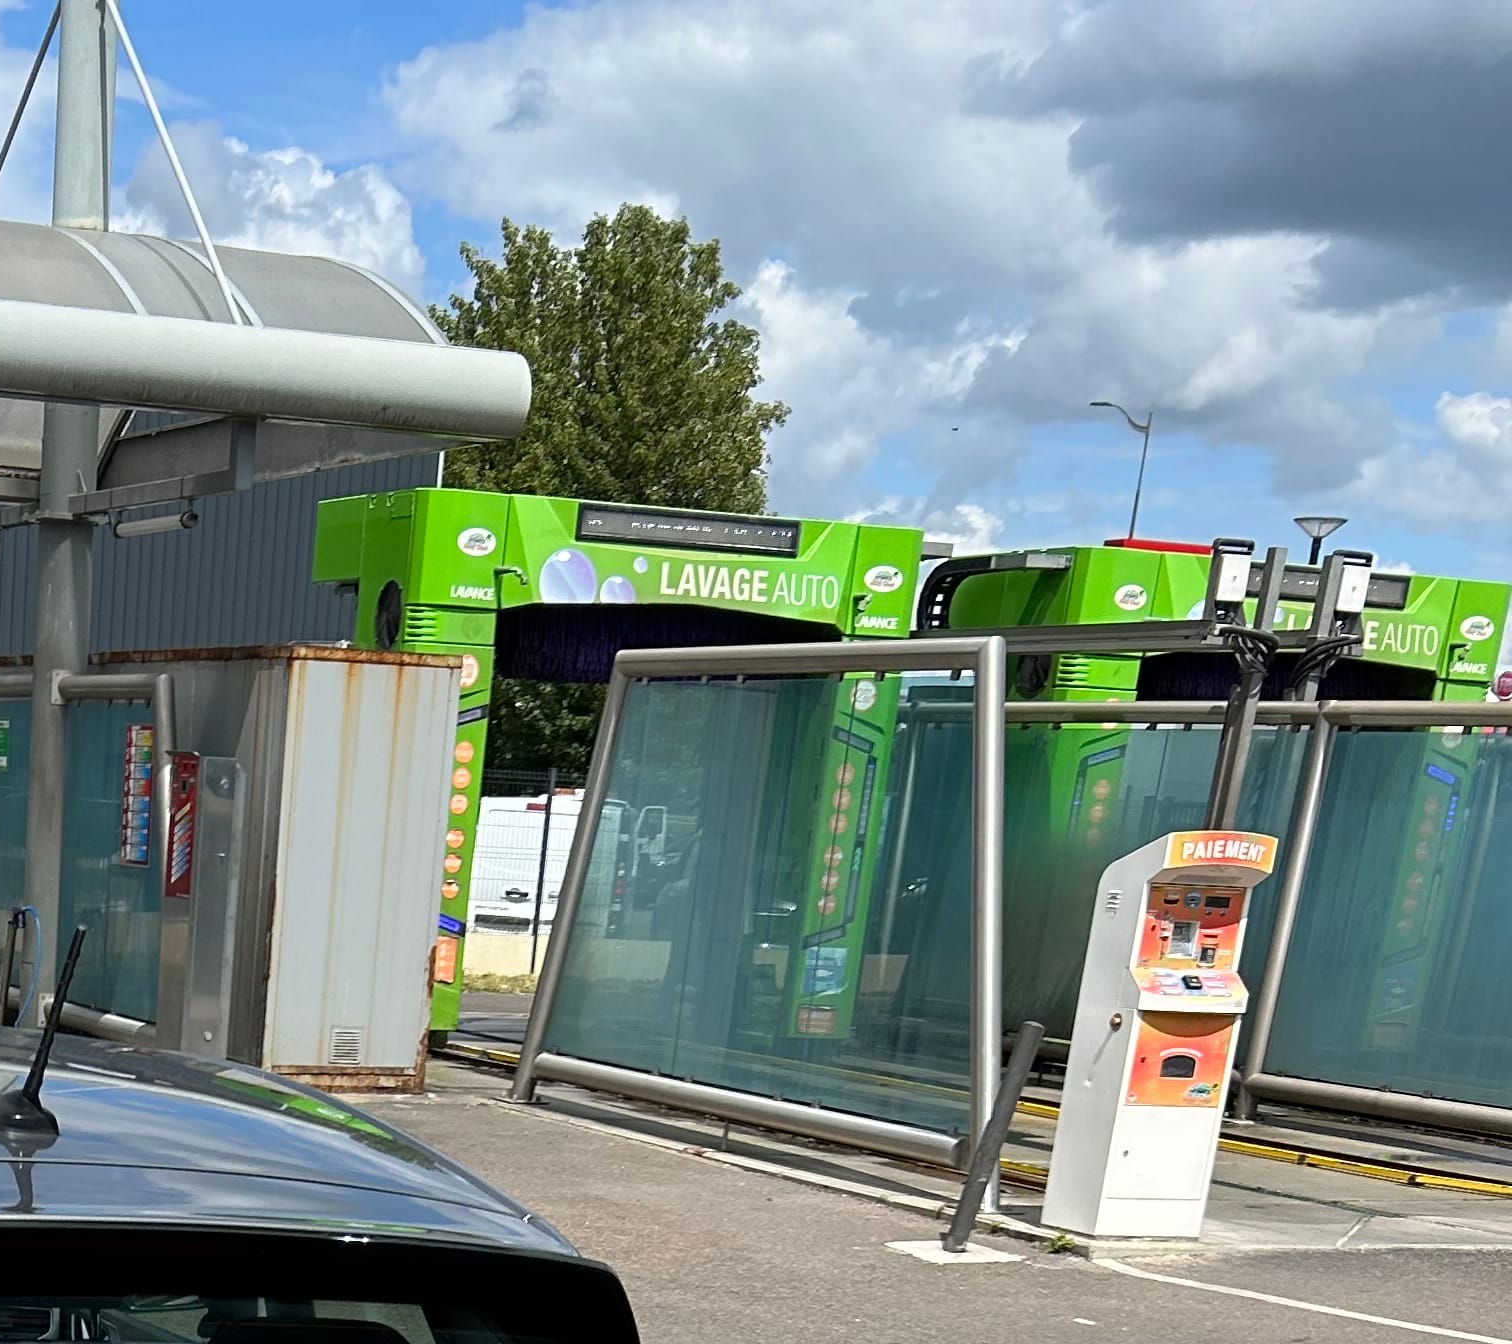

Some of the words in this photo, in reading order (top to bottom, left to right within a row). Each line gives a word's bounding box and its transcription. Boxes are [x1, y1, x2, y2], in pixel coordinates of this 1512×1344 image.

[449, 584, 495, 601] LAVANCE
[660, 561, 769, 604] LAVAGE
[771, 571, 840, 610] AUTO
[1379, 621, 1439, 657] AUTO
[1181, 839, 1267, 863] PAIEMENT
